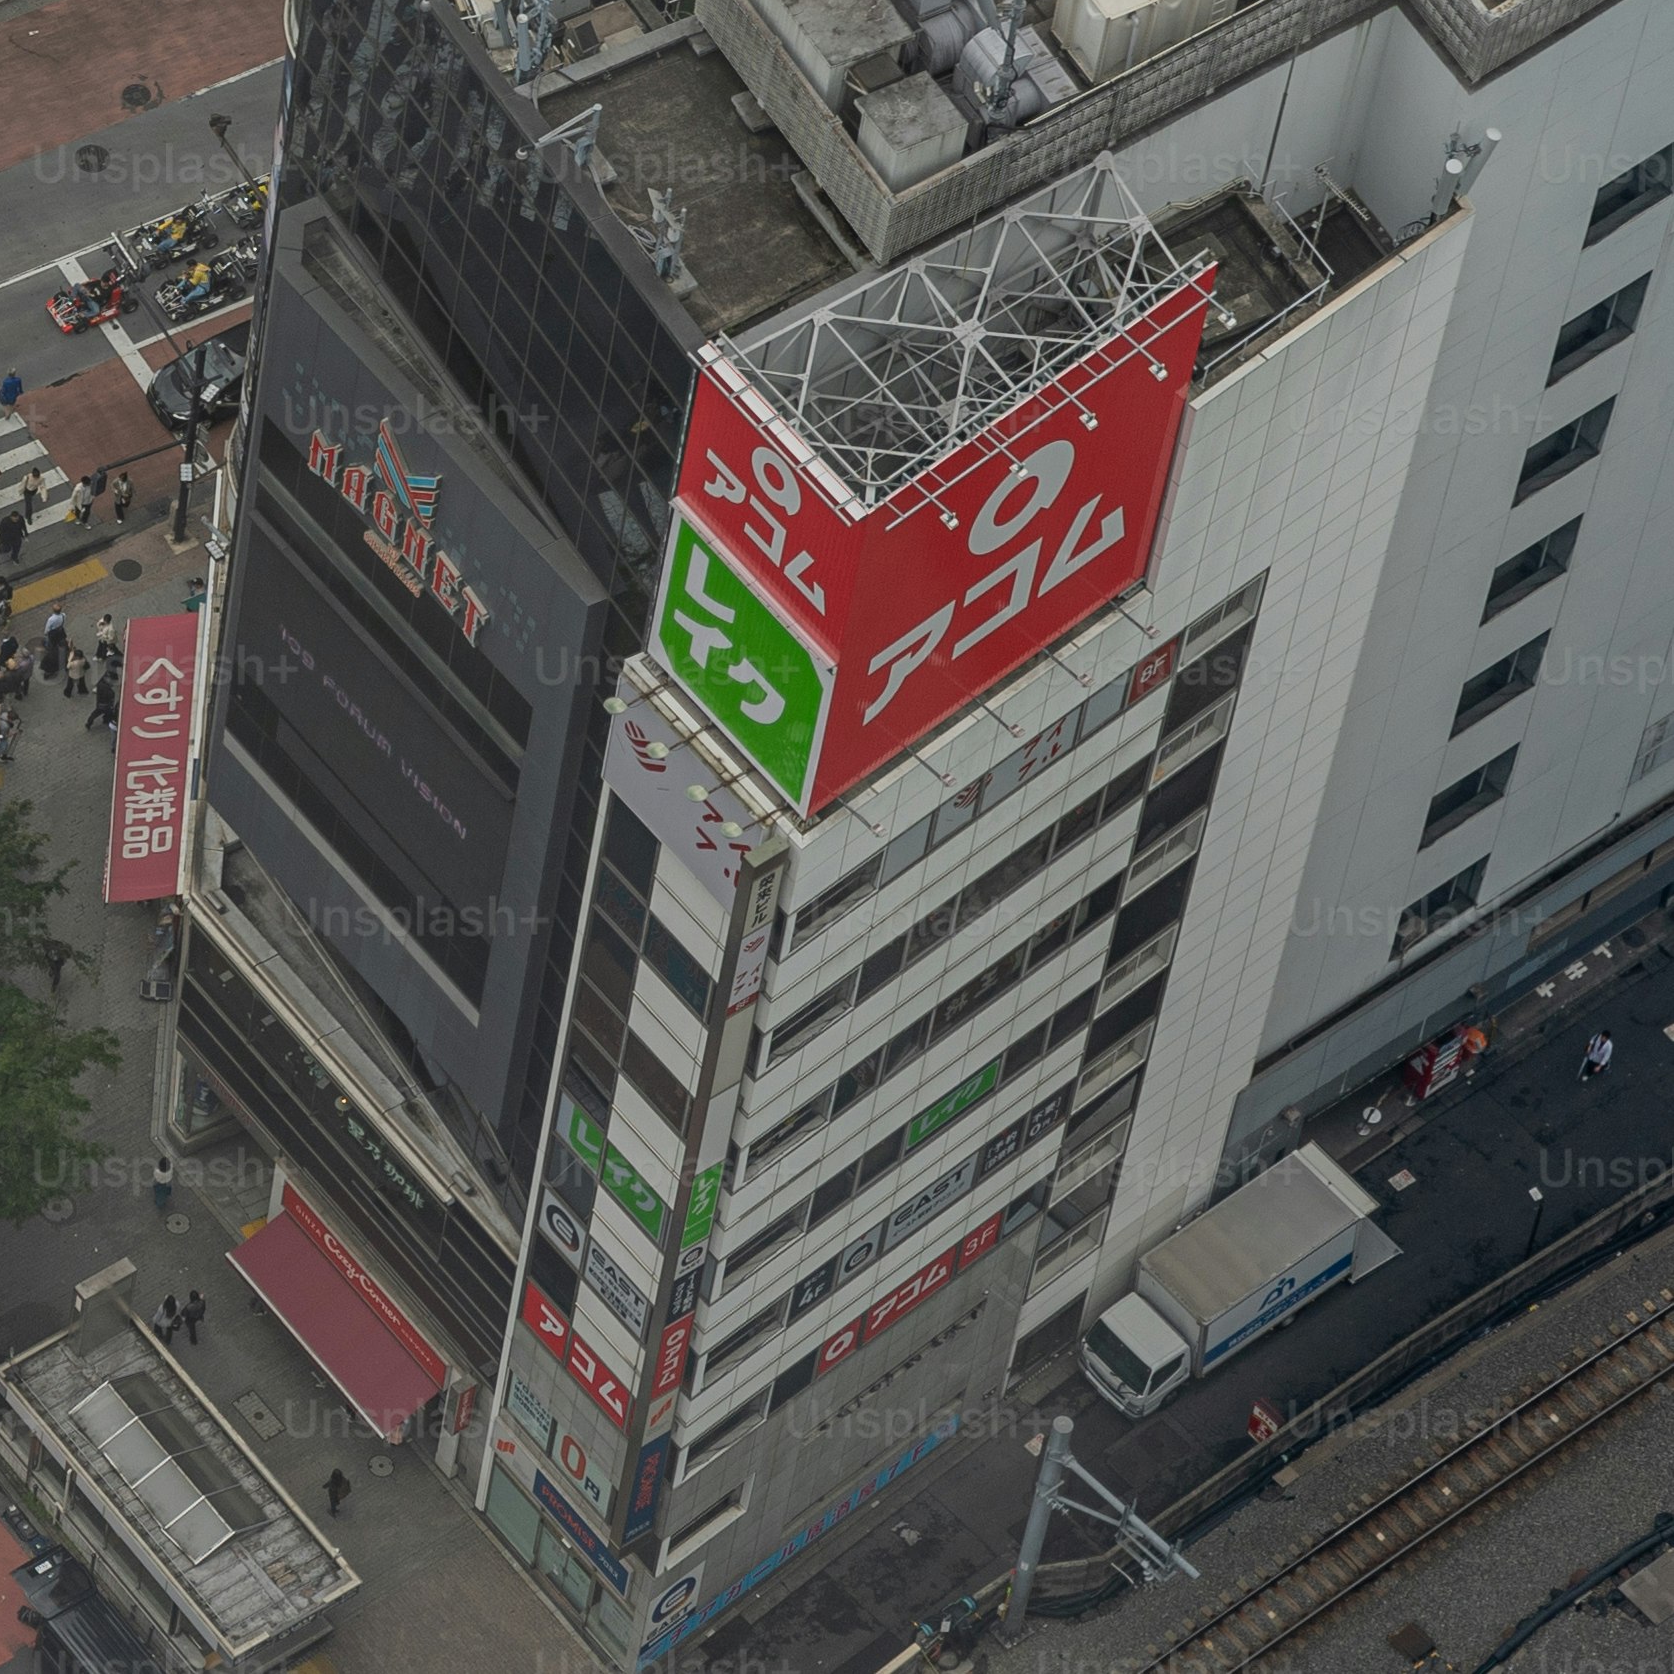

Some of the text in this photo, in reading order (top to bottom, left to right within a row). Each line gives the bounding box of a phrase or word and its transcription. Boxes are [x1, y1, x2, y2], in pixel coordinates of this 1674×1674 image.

[306, 428, 491, 648] MAGNET
[705, 447, 827, 618] アコム
[673, 542, 787, 725] レイク
[862, 492, 1126, 727] アコム
[122, 655, 185, 861] くすり 化粧品
[322, 674, 393, 758] FORUM
[577, 1117, 657, 1213] レイク
[869, 1263, 948, 1330] アコム
[964, 1223, 997, 1258] 3F
[536, 1300, 625, 1418] アコム
[541, 1485, 596, 1549] PROMISE
